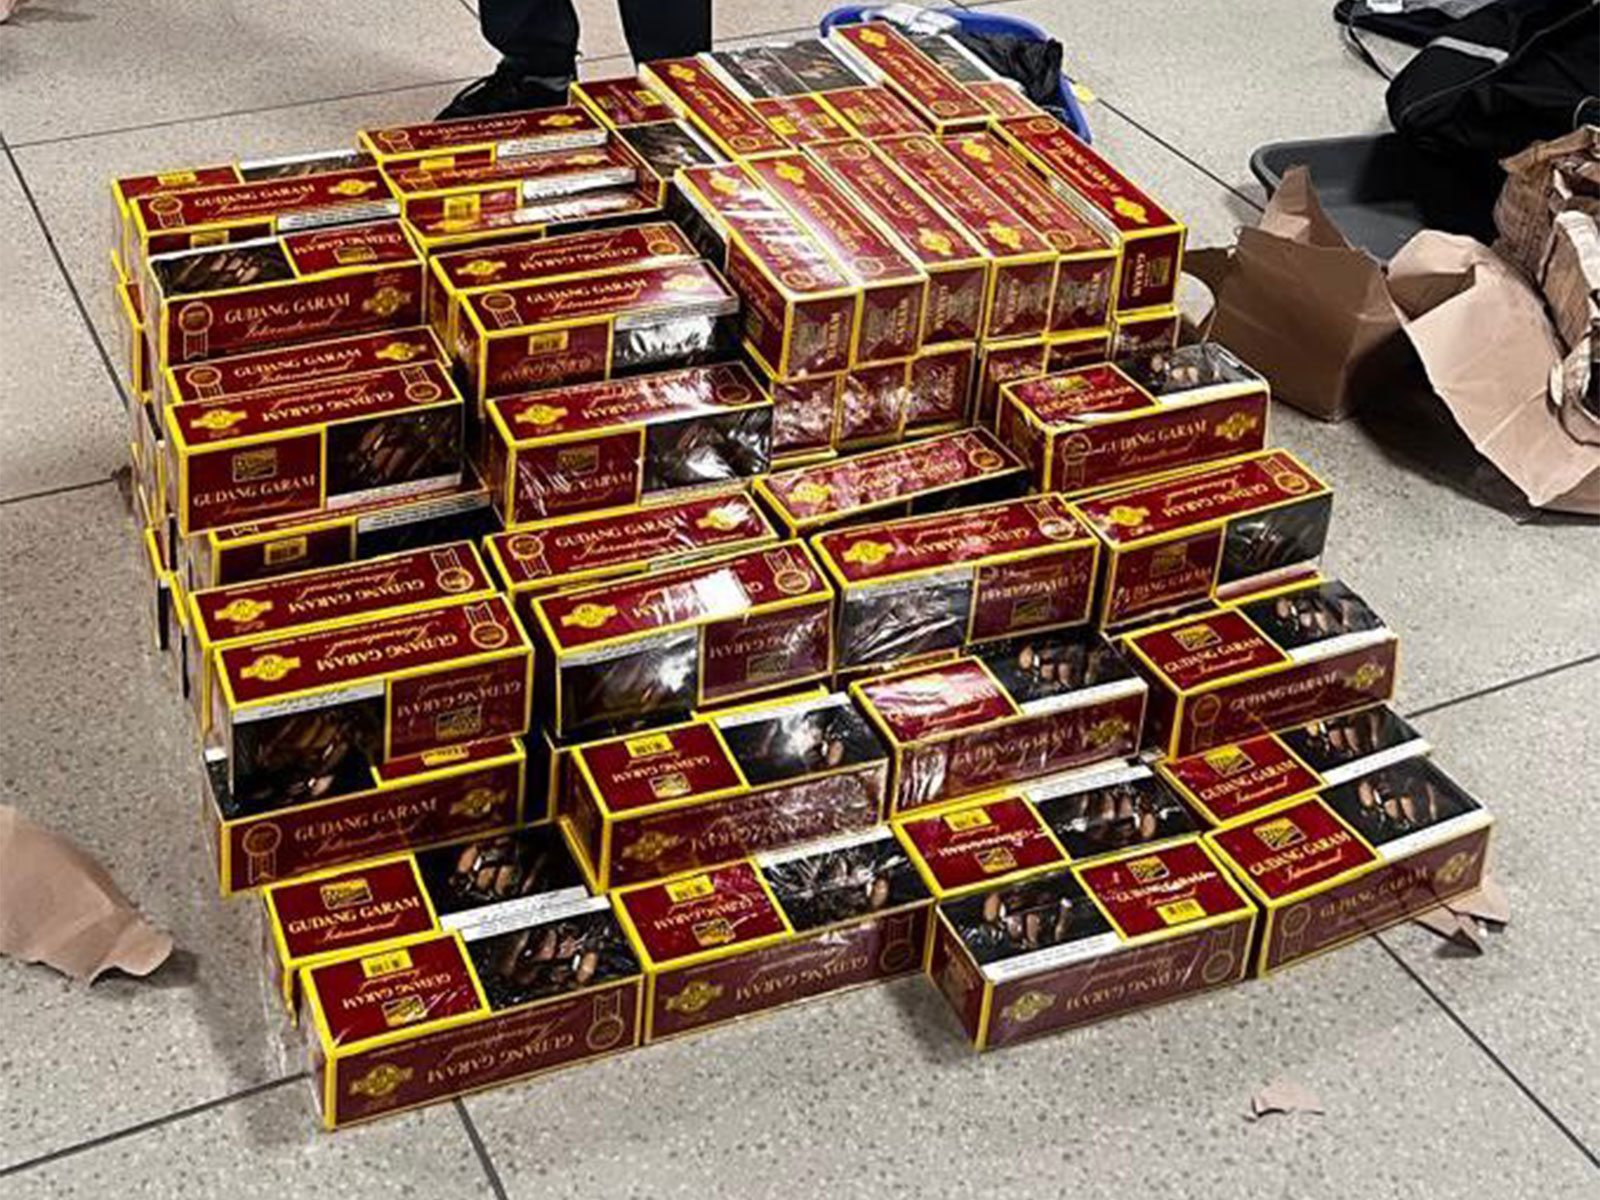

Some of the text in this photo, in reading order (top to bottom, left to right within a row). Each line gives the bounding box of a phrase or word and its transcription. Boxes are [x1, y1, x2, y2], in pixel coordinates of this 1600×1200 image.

[527, 278, 648, 304] GUDANG GARAM
[225, 292, 351, 325] GUDANG GARAM
[234, 348, 363, 378] GUDANG GARAM
[261, 389, 395, 423] GUDANG GARAM
[192, 473, 317, 508] GUDANG GARAM
[555, 514, 686, 549] GUDANG GARAM
[288, 590, 352, 614] GARAM
[355, 577, 426, 603] GUDANG
[315, 648, 382, 673] GARAM
[384, 632, 459, 659] GUDANG
[1163, 635, 1265, 674] GUDANG GARAM
[397, 695, 452, 719] GARAM
[454, 679, 522, 708] GUDANG
[1201, 757, 1300, 801] GUDANG GARAM
[294, 796, 439, 843] GUDANG GARAM
[1250, 829, 1353, 877] GUDANG GARAM
[288, 909, 357, 935] GUDANG
[359, 896, 421, 919] GARAM
[341, 973, 452, 1010] GUDANG GARAM
[735, 954, 869, 1000] GUDANG GARAM
[426, 1033, 575, 1084] GUDANG GARAM
